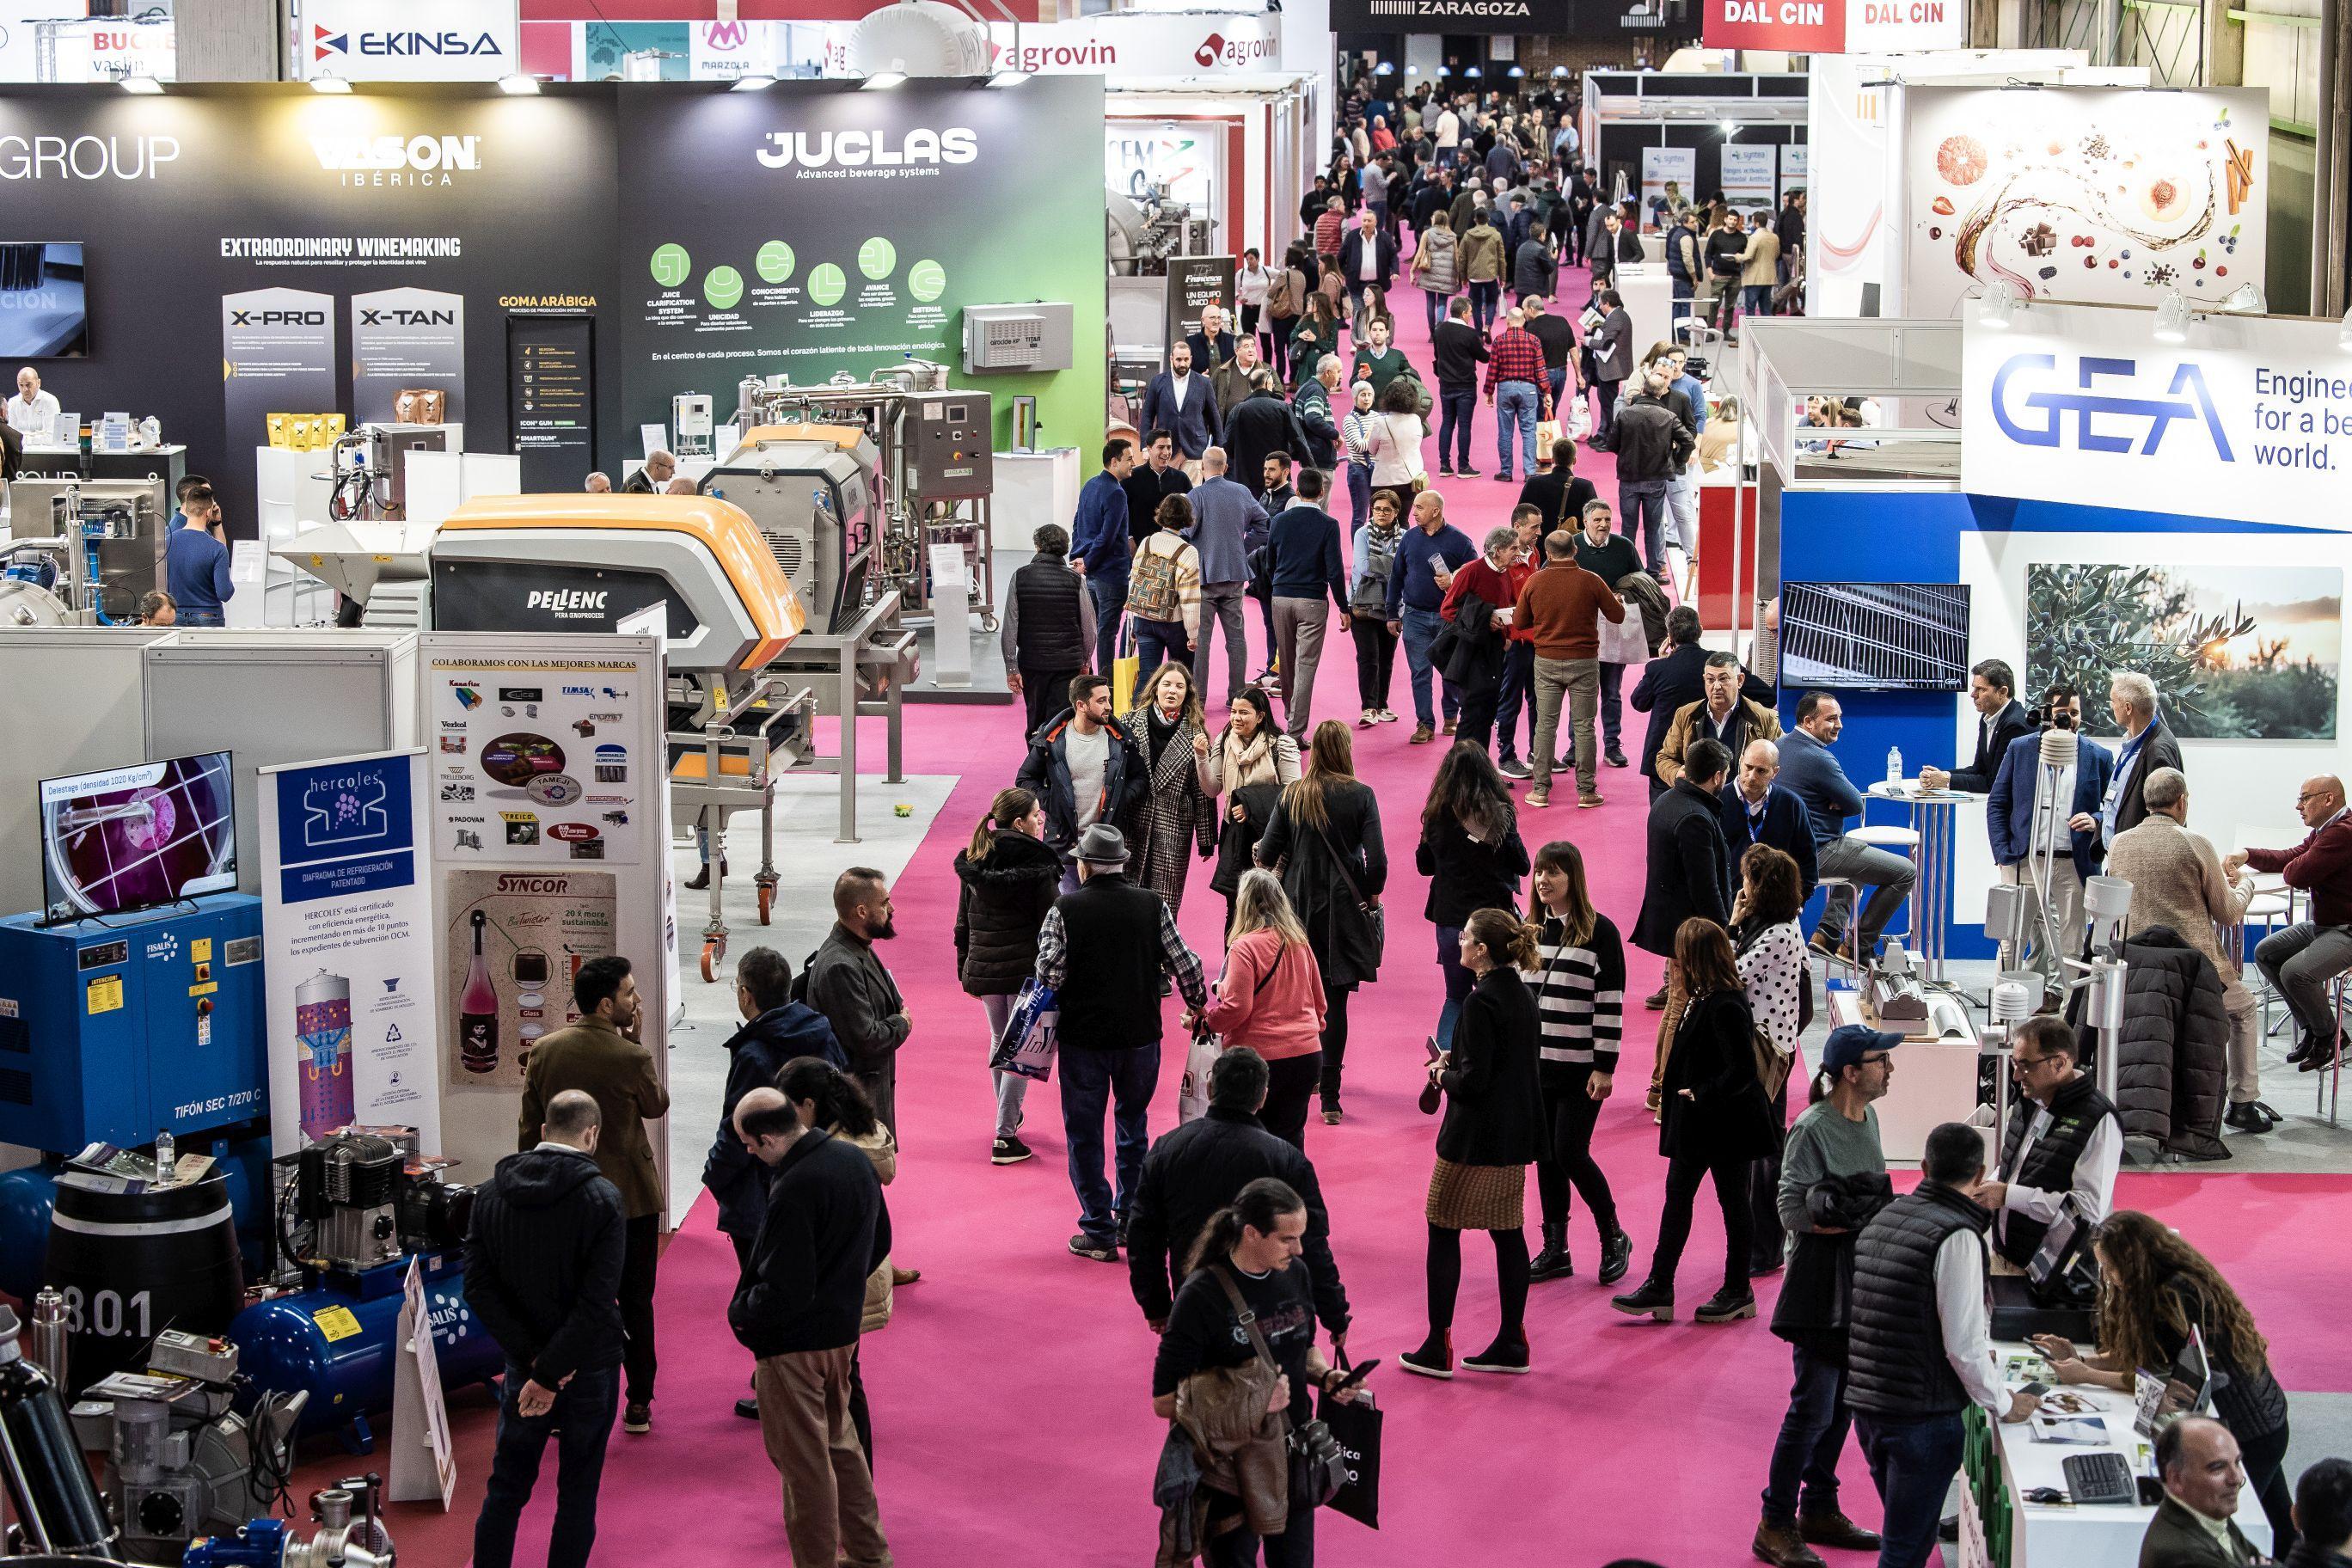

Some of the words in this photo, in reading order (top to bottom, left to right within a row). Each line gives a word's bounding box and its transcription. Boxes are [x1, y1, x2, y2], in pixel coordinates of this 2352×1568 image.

[1418, 1, 1530, 15] ZARAGOZA
[1724, 0, 1772, 23] DAL
[1779, 1, 1823, 25] CIN
[1865, 3, 1905, 24] DAL
[1910, 2, 1945, 23] CIN
[360, 33, 503, 55] EKINSA
[1227, 32, 1277, 65] agrovin
[1006, 39, 1116, 73] agrovin
[0, 135, 181, 180] GROUP
[756, 127, 978, 168] JUCLAS
[342, 170, 452, 187] IBÉRICA
[796, 168, 847, 179] Advanced
[849, 168, 896, 179] beverage
[899, 167, 940, 178] systems
[221, 237, 352, 257] EXTRAORDINARY
[357, 237, 461, 256] WINEMAKING
[499, 296, 539, 307] GOMA
[541, 293, 597, 307] ARÁBIGA
[750, 287, 800, 296] CONOCIMIENTO
[1197, 291, 1222, 299] EQUIPO
[230, 310, 325, 326] X-PRO
[359, 309, 454, 326] X-TAN
[671, 352, 695, 360] centro
[726, 350, 756, 359] proceso.
[790, 346, 818, 355] corazón
[819, 346, 846, 354] latiente
[874, 343, 911, 352] innovación
[911, 341, 946, 351] enológica.
[2256, 367, 2352, 404] Engine
[1991, 352, 2236, 462] GEA
[2254, 402, 2291, 432] for
[2300, 413, 2314, 433] a
[2254, 442, 2336, 471] world.
[527, 589, 608, 611] PELLENC
[432, 658, 505, 667] COLABORAMOS
[551, 660, 596, 670] MEJORES
[48, 783, 79, 795] Delestage
[80, 779, 109, 792] (densidad
[537, 776, 570, 786] TAMEJI
[302, 870, 336, 883] DIAFRAGMA
[337, 868, 346, 877] DE
[346, 861, 394, 876] REFRIGERACIÓN
[331, 877, 365, 889] PATENTADO
[496, 873, 568, 893] SYNCOR
[344, 904, 358, 914] está
[359, 900, 394, 913] certificado
[322, 917, 353, 928] eficiencia
[355, 912, 391, 924] energética,
[291, 931, 341, 945] incrementando
[352, 927, 365, 935] más
[367, 924, 376, 933] de
[377, 922, 385, 932] 10
[387, 920, 409, 932] puntos
[147, 941, 171, 953] FISALIS
[290, 946, 300, 956] los
[302, 941, 341, 955] expedientes
[343, 939, 352, 947] de
[352, 933, 389, 946] subvención
[390, 930, 411, 940] OCM.
[175, 1099, 205, 1119] TIFÓN
[205, 1097, 226, 1112] SEC
[228, 1090, 252, 1108] 7/270
[254, 1088, 261, 1100] C
